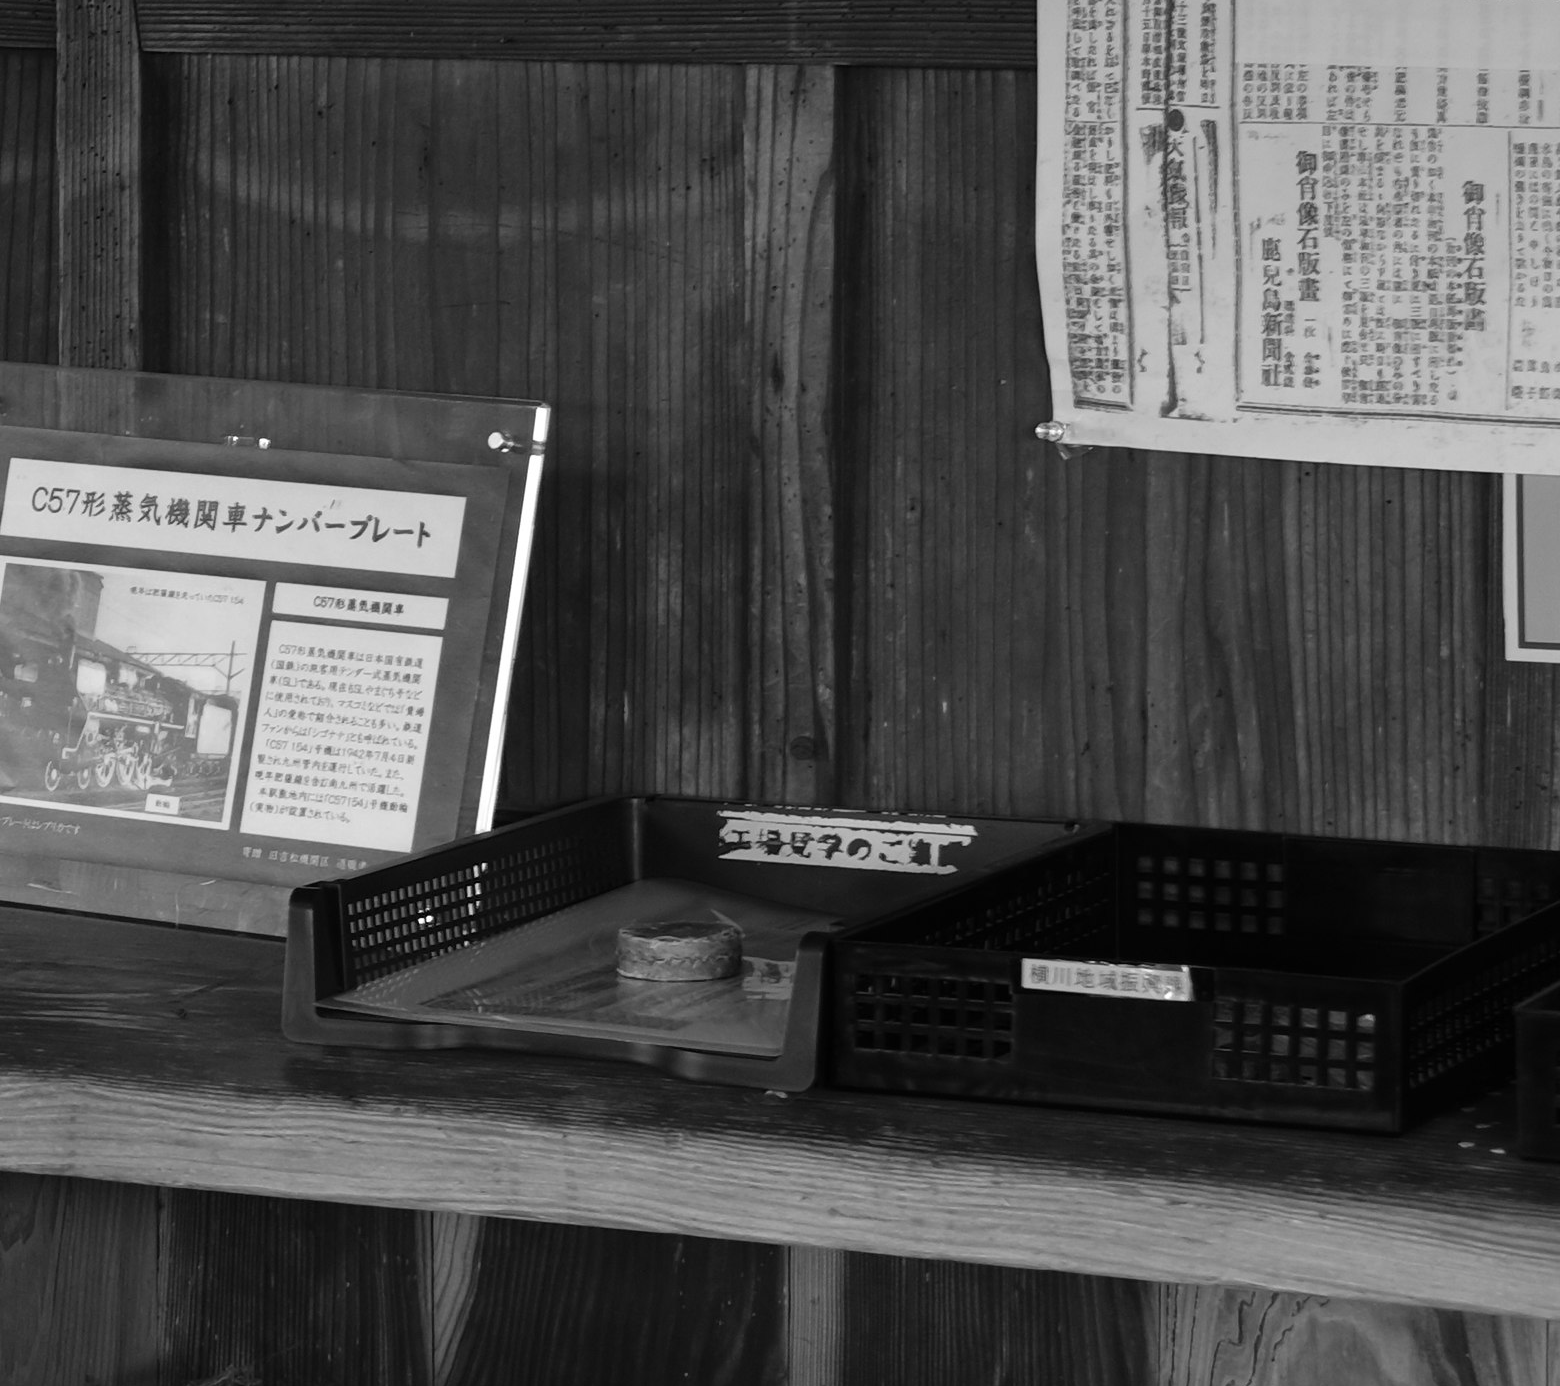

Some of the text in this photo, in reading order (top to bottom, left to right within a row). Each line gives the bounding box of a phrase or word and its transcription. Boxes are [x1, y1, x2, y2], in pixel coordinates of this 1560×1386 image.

[31, 485, 431, 549] C57形蒸気機関車ナンバープレート
[313, 595, 405, 617] C57形蒸気機関車
